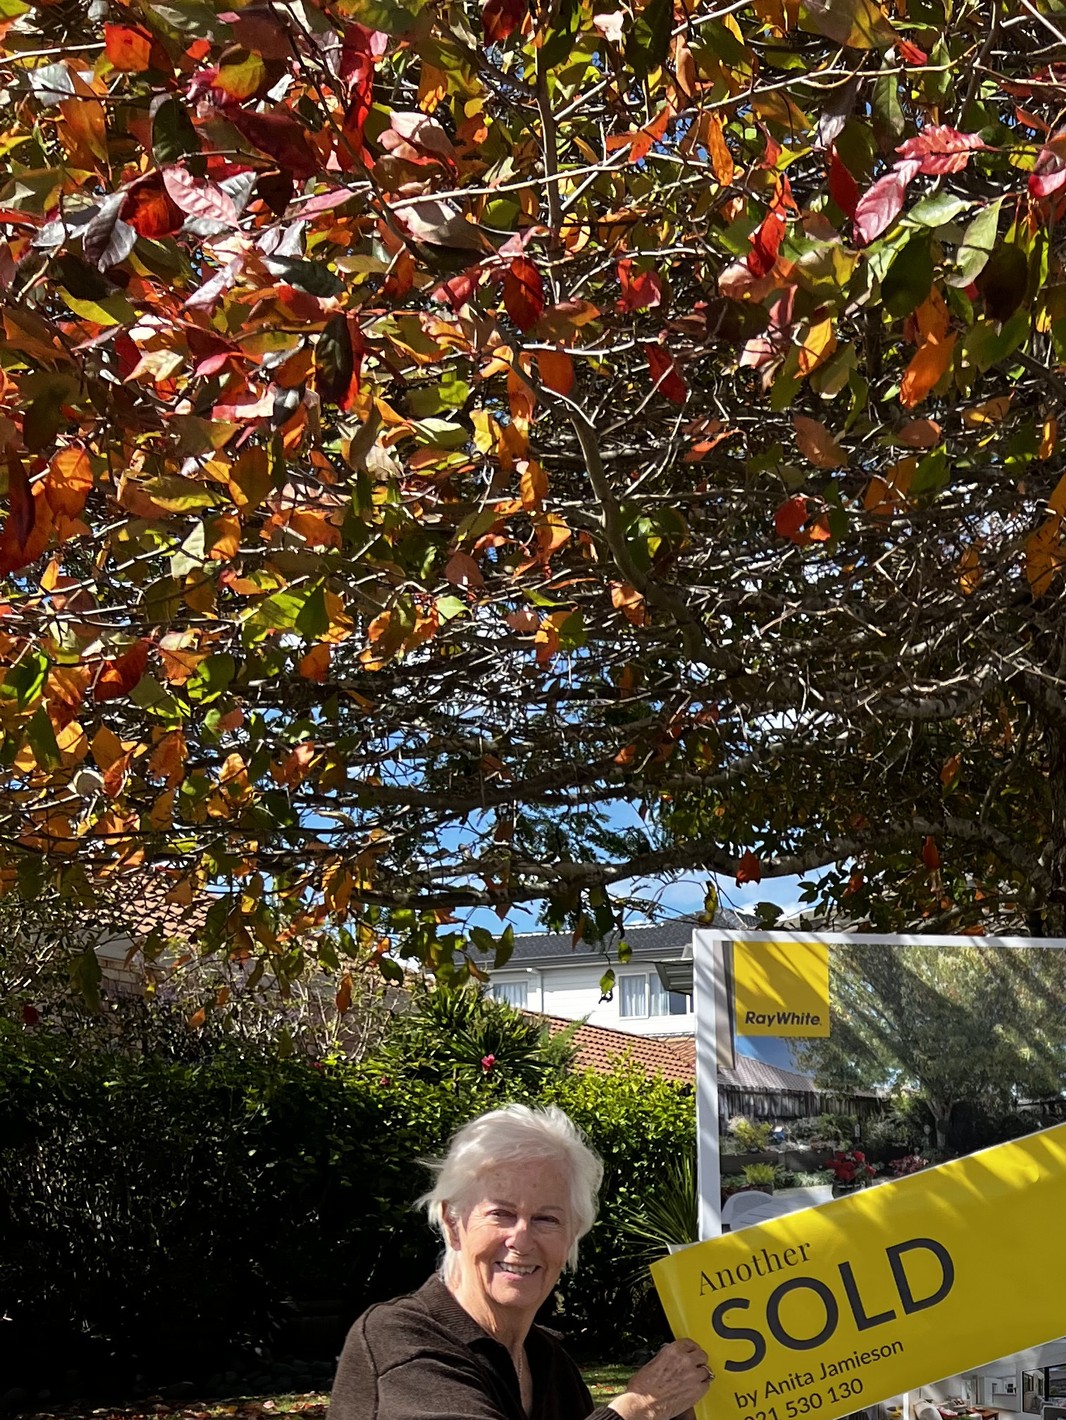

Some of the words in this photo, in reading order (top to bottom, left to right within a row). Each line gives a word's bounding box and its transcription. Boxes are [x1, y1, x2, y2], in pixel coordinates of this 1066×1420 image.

[699, 1242, 811, 1296] Another
[711, 1237, 955, 1372] SOLD
[734, 1391, 758, 1409] by
[764, 1373, 815, 1399] Anita
[819, 1341, 904, 1380] Jamieson
[786, 1393, 823, 1419] 530
[827, 1378, 864, 1404] 130
